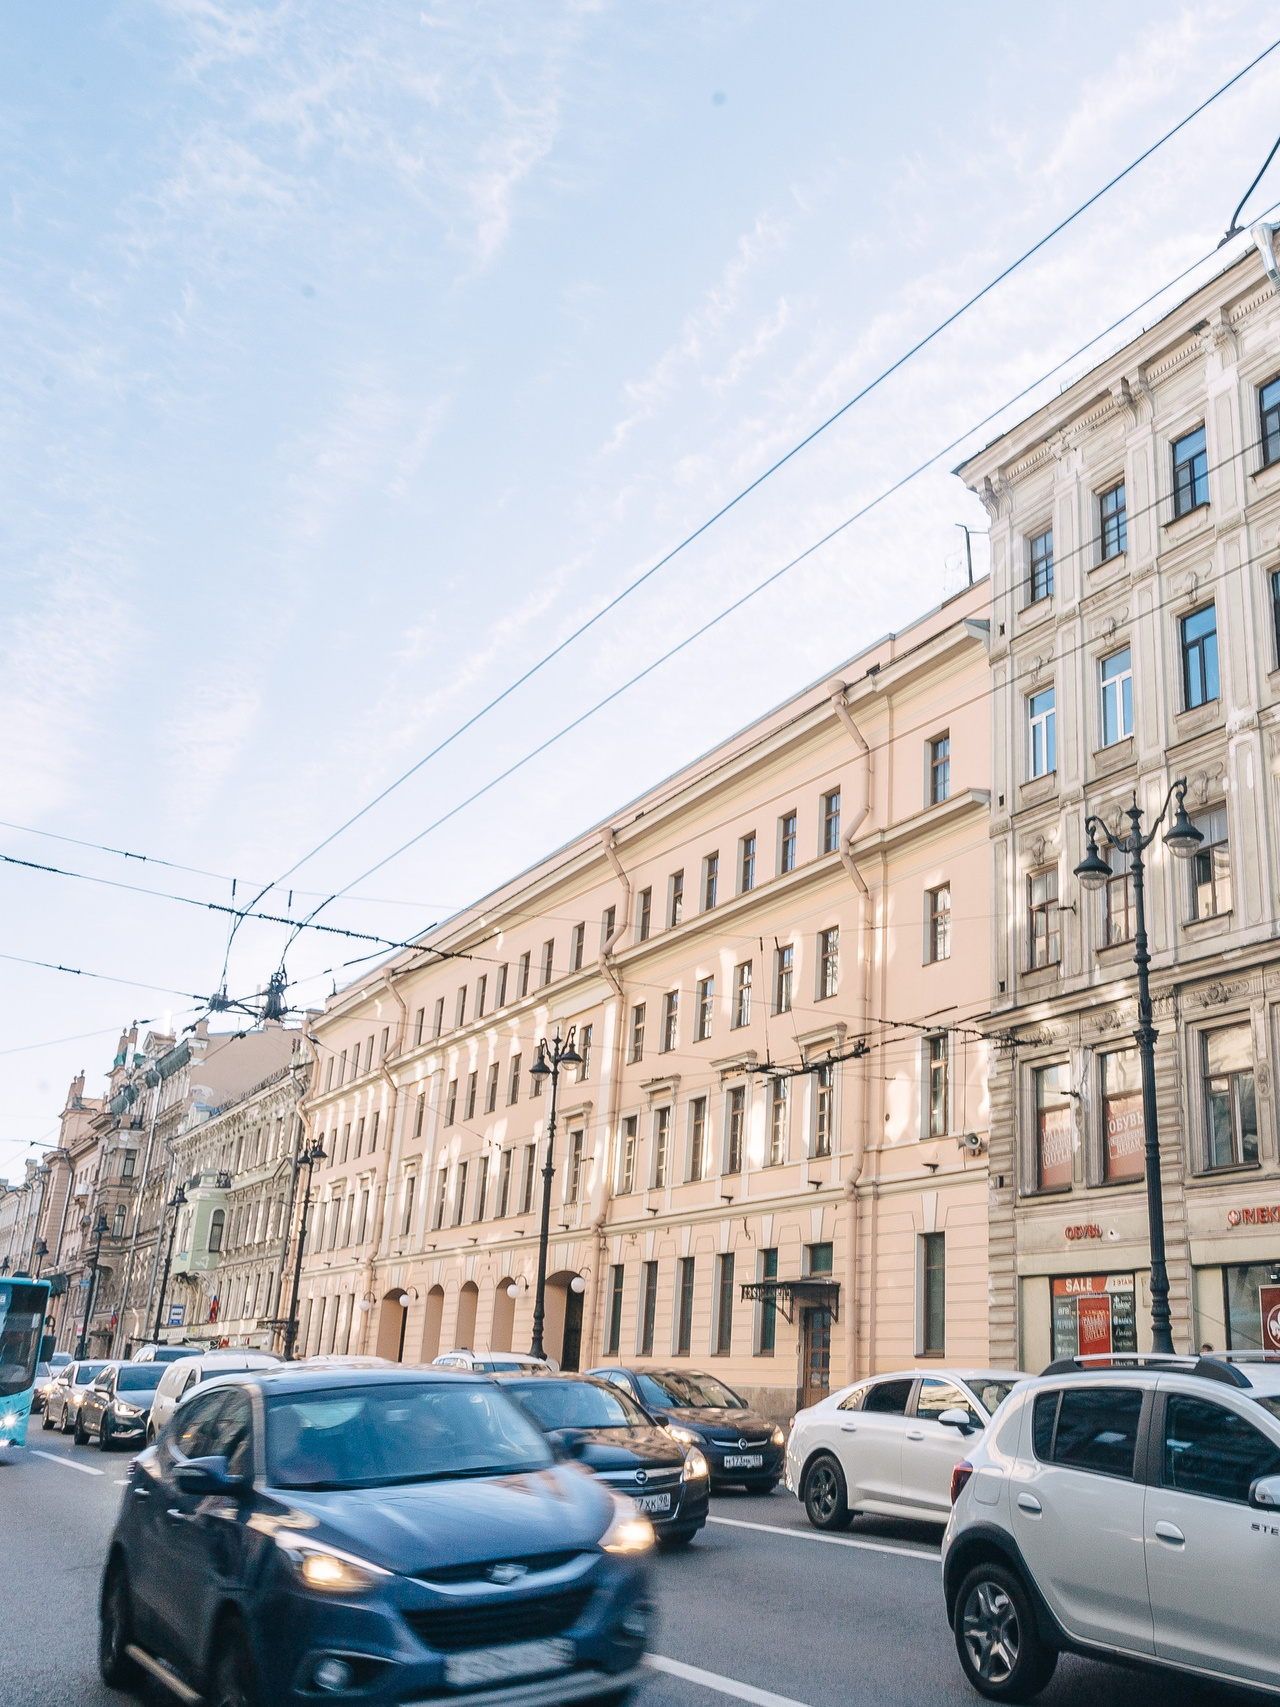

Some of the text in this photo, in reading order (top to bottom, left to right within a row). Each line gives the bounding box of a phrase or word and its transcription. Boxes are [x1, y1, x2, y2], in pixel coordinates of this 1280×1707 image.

[1108, 1110, 1144, 1135] ОБУВЬ
[1065, 1223, 1101, 1240] ОБУВЬ
[1065, 1278, 1093, 1293] SALE
